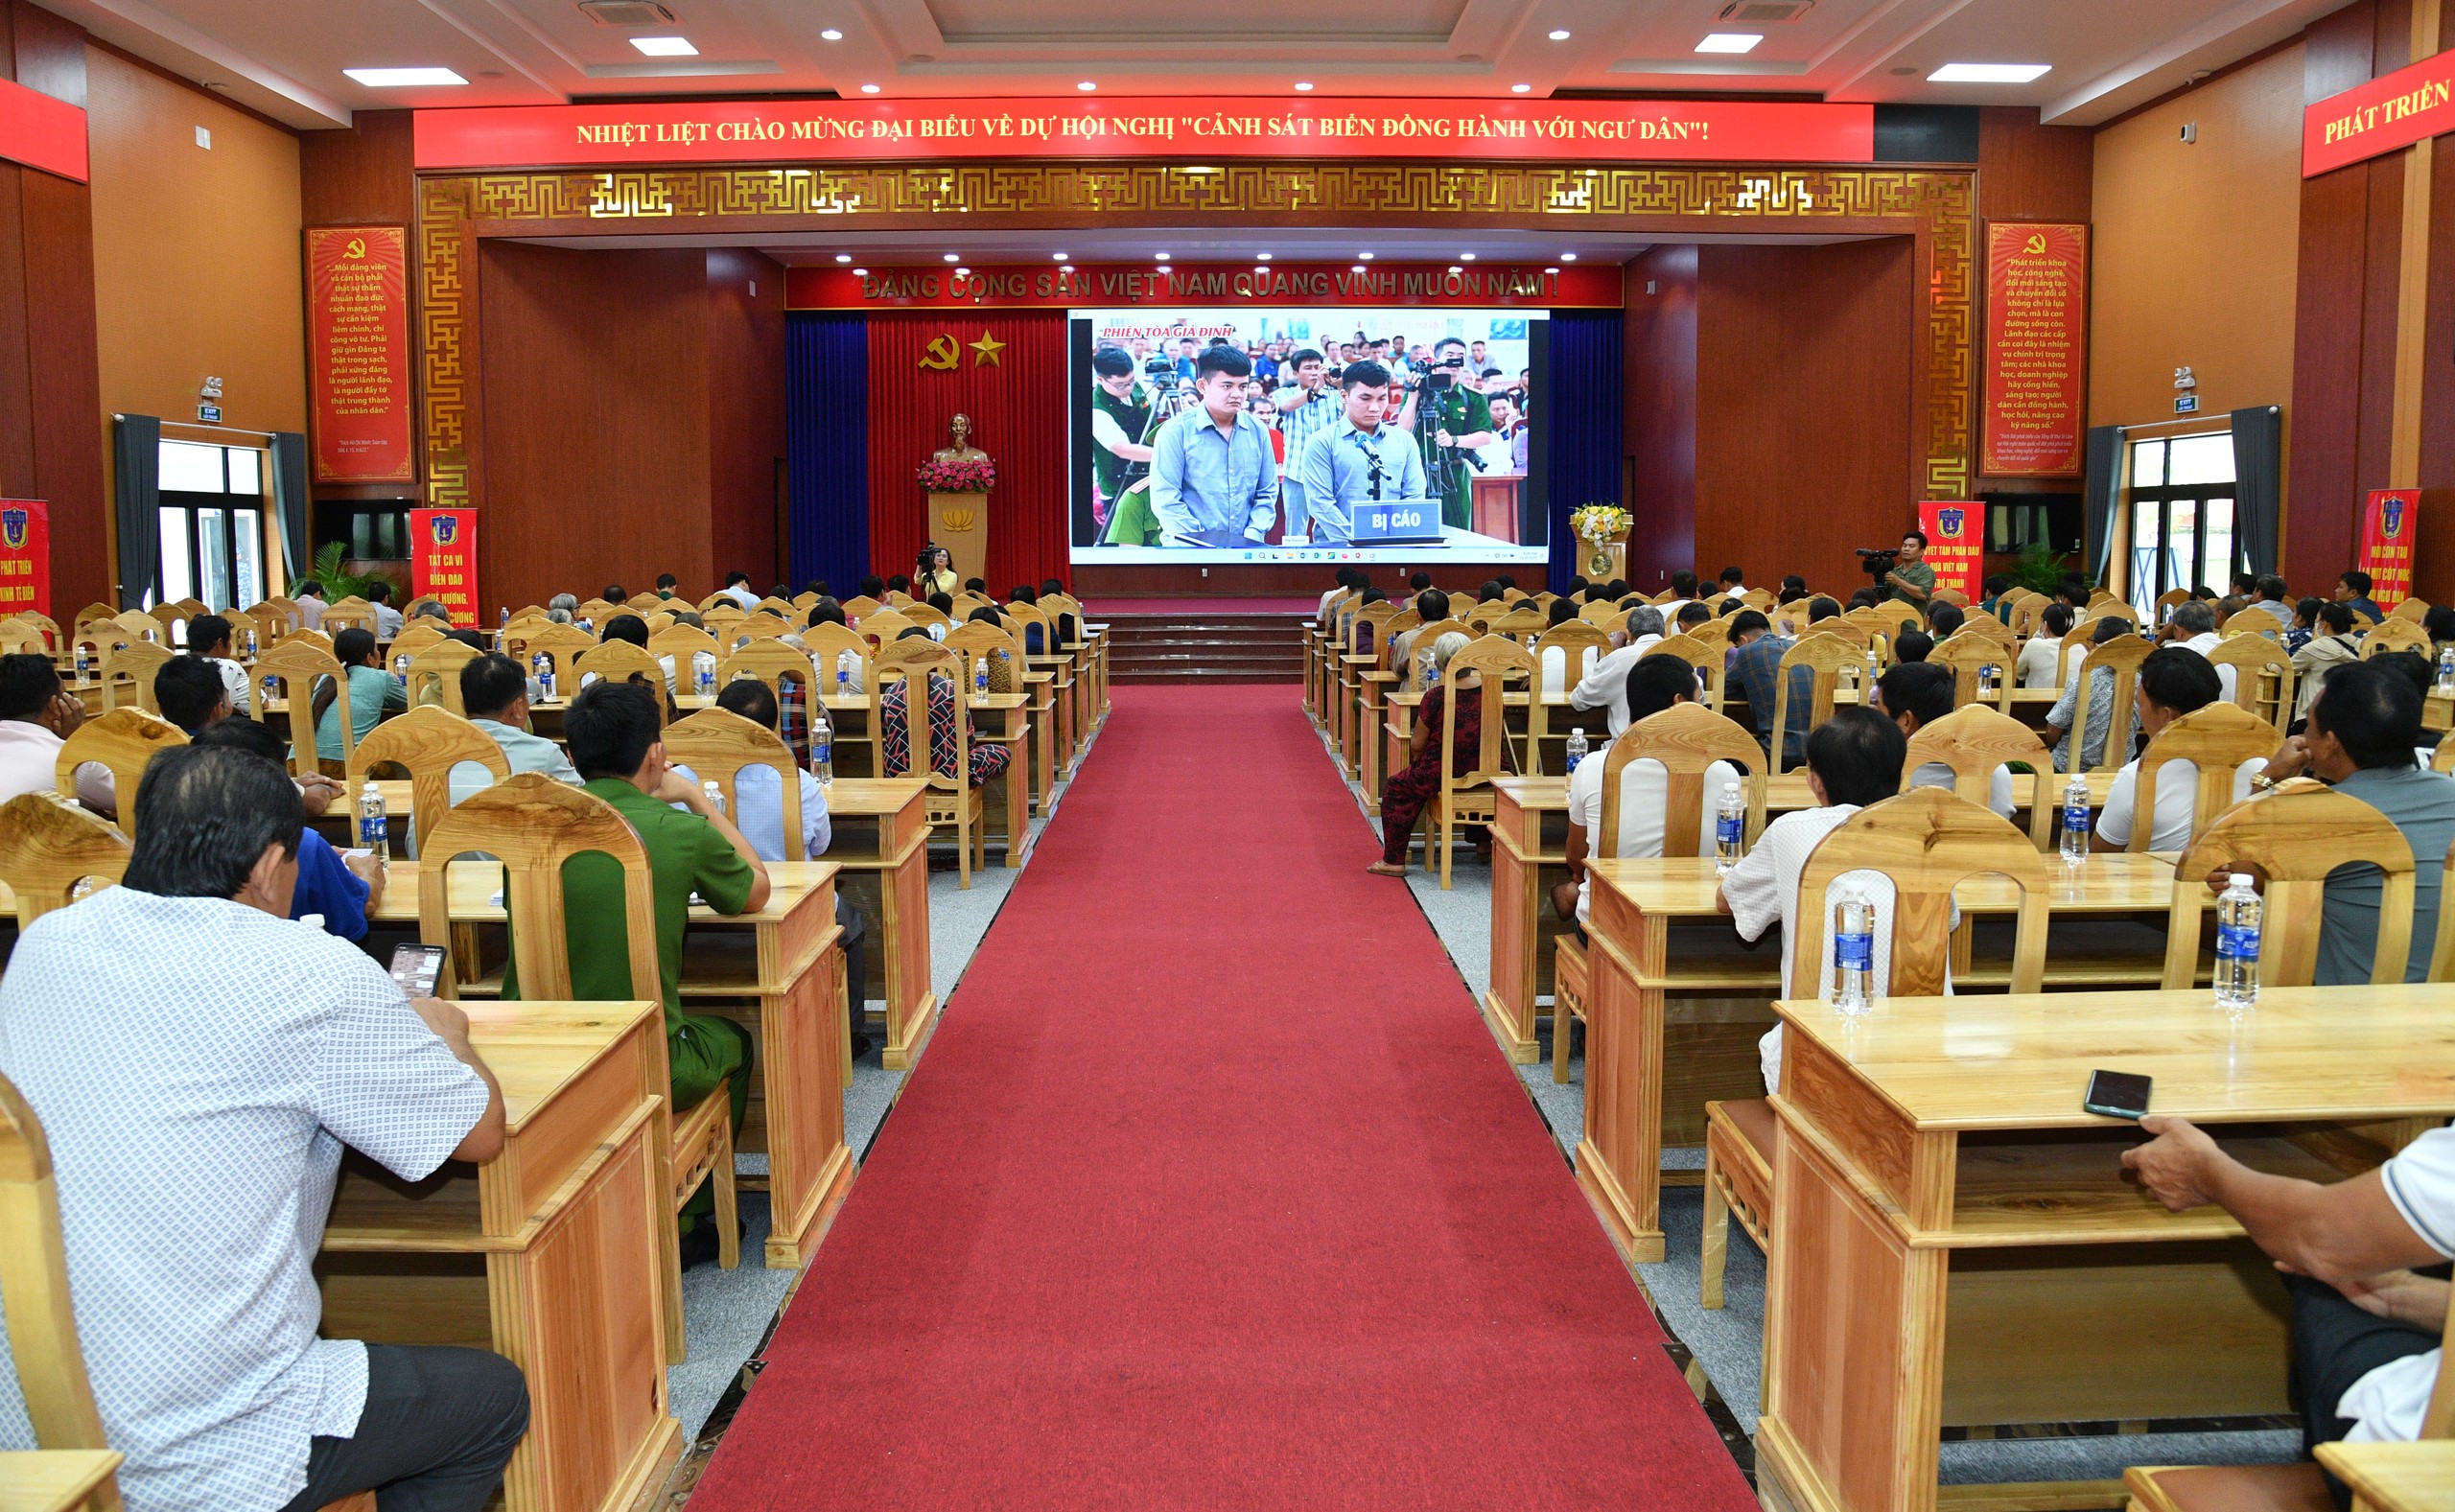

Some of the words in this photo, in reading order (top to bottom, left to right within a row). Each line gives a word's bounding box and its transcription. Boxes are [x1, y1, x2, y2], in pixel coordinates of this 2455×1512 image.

[577, 123, 650, 147] NHIỆT
[657, 122, 711, 146] LIỆT
[716, 118, 784, 140] CHÀO
[791, 116, 865, 139] MỪNG
[871, 119, 913, 142] ĐẠI
[982, 113, 1014, 136] VỀ
[1020, 115, 1057, 140] DỰ
[1062, 115, 1107, 140] HỘI
[1112, 117, 1174, 140] NGHỊ
[1181, 112, 1261, 136] "CẢNH
[1268, 113, 1313, 136] SÁT
[1382, 114, 1450, 137] ĐỒNG
[1458, 114, 1526, 137] HÀNH
[1532, 116, 1575, 138] VỚI
[1581, 118, 1635, 140] NGƯ
[1640, 117, 1708, 140] DÂN"!
[2325, 105, 2378, 145] PHÁT
[862, 268, 940, 298] ĐẢNG
[948, 269, 1027, 303] CỘNG
[1036, 268, 1091, 297] SẢN
[1100, 269, 1159, 301] VIỆT
[1169, 273, 1227, 296] NAM
[1233, 272, 1328, 297] QUANG
[1336, 272, 1395, 296] VINH
[1403, 268, 1481, 296] MUÔN
[2055, 280, 2067, 289] tạo
[356, 295, 368, 304] đạo
[2008, 310, 2027, 318] chọn,
[1103, 325, 1141, 337] PHIÊN
[1145, 325, 1170, 337] TÒA
[1173, 325, 1196, 337] GIẢ
[1199, 327, 1232, 338] ĐỊNH
[2024, 330, 2038, 338] đạo
[2047, 340, 2070, 349] nhiệm
[358, 345, 377, 354] Đảng
[332, 357, 345, 365] thật
[369, 356, 386, 364] sạch,
[2001, 411, 2015, 420] học
[1372, 513, 1387, 531] BỊ
[1391, 509, 1420, 527] CÁO
